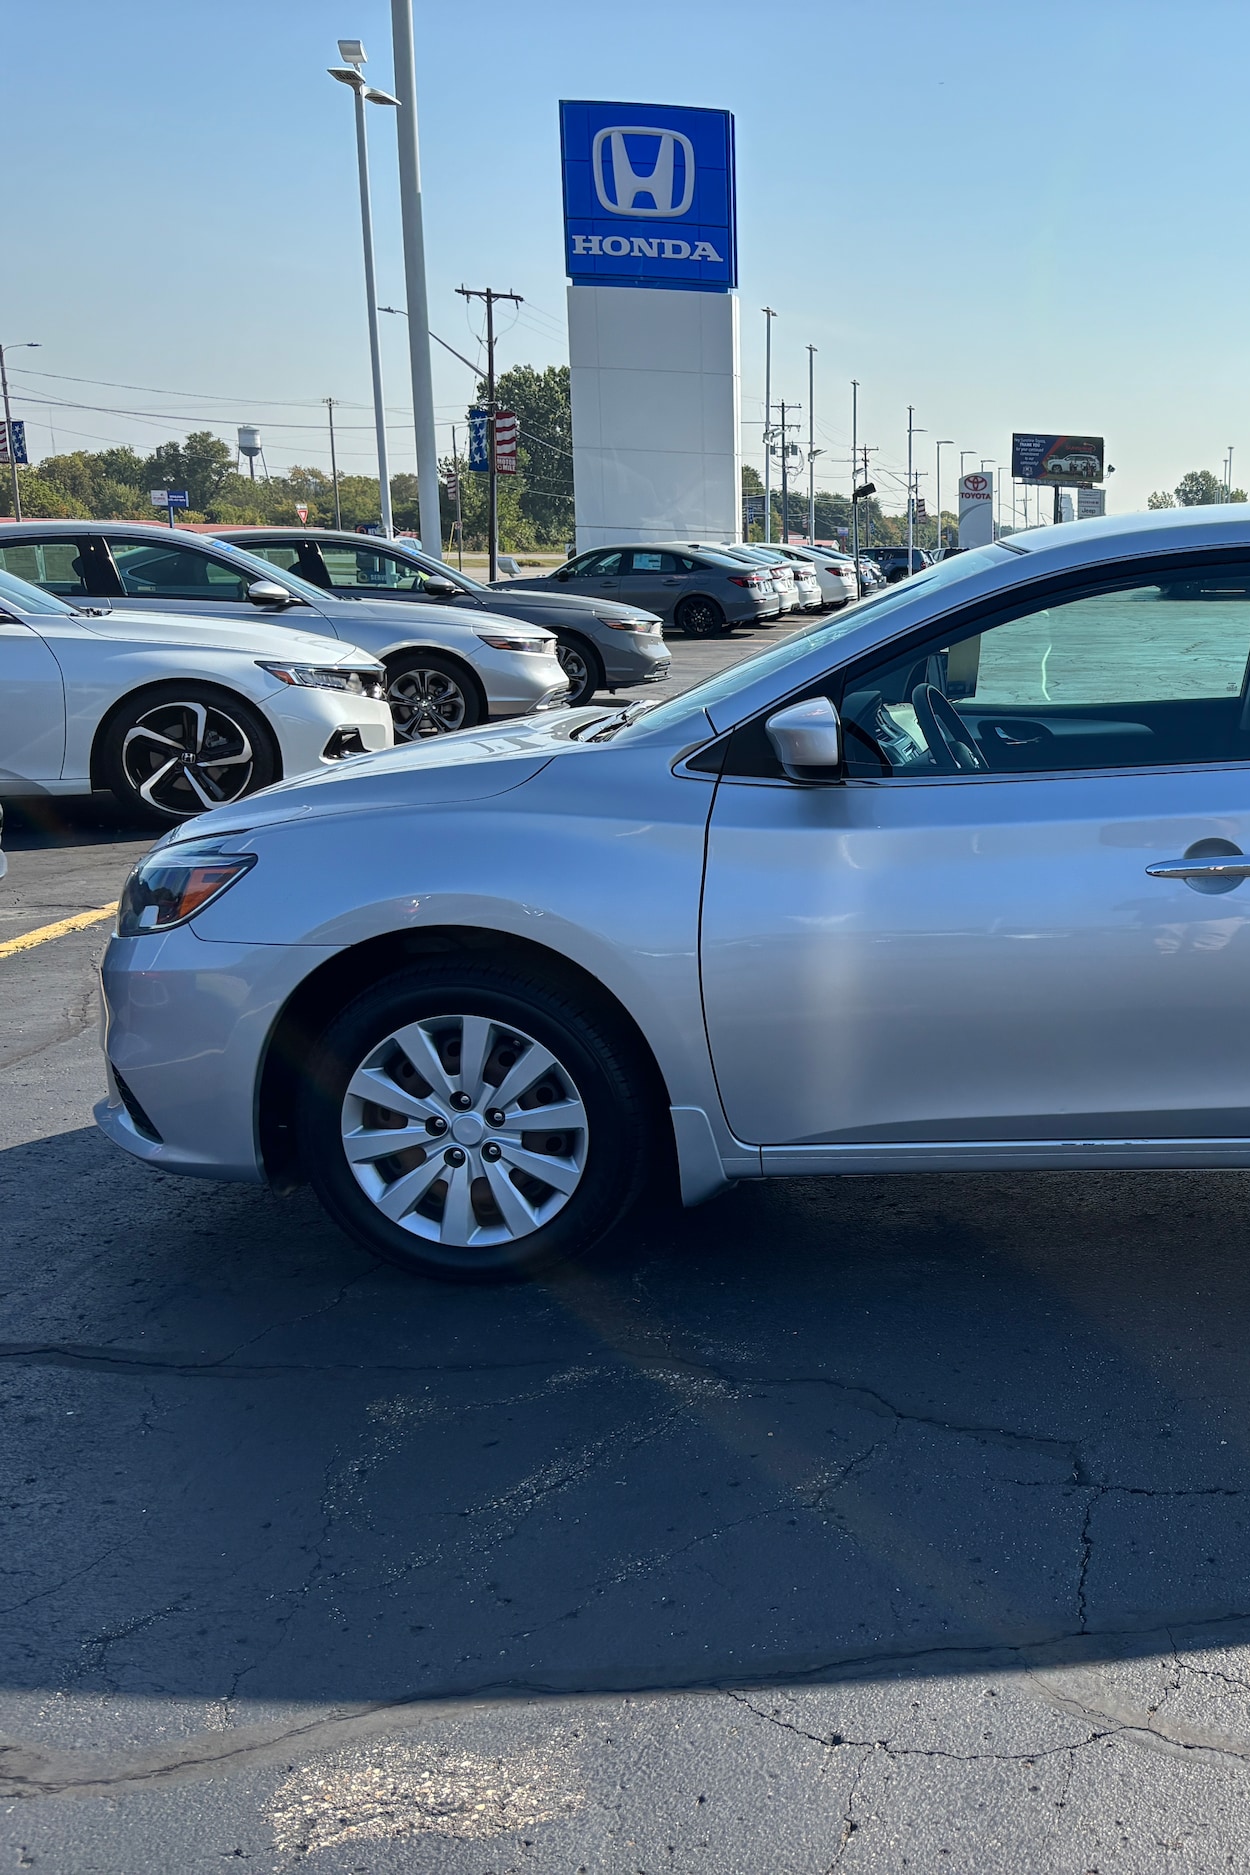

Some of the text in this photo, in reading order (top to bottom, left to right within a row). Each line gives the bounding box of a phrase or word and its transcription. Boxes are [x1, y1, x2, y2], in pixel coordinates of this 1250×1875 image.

[572, 235, 724, 262] HONDA
[497, 458, 516, 466] MOTOR
[961, 492, 992, 500] TOYOTA
